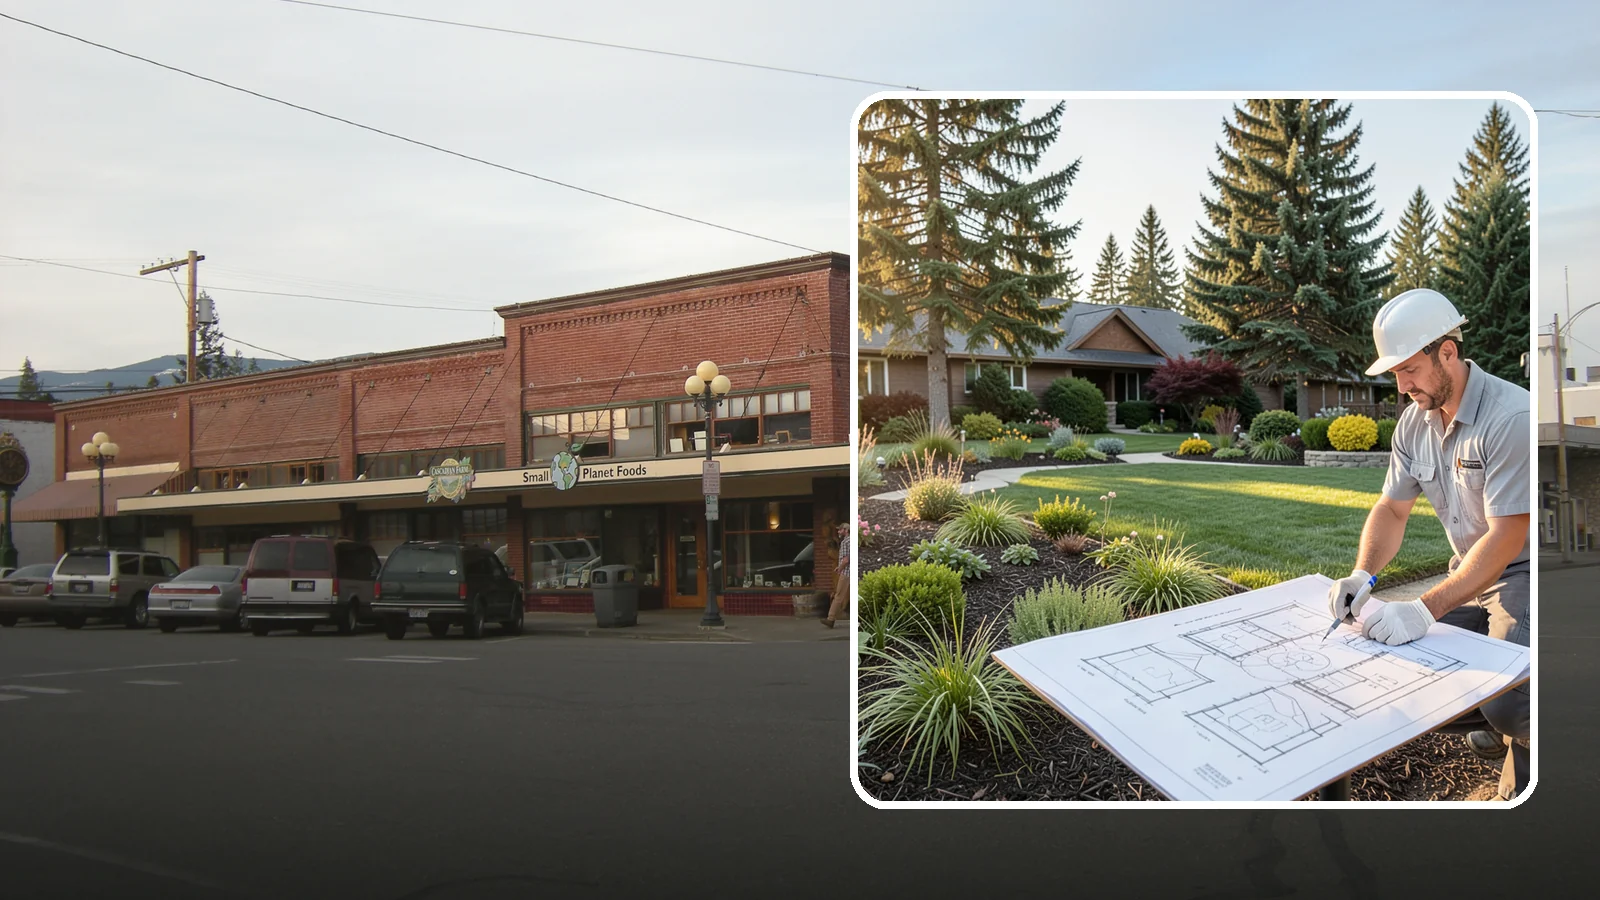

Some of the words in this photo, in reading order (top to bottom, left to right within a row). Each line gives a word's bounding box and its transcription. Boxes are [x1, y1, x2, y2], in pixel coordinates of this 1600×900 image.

[523, 471, 548, 482] Small
[583, 468, 614, 479] Planet
[617, 464, 647, 477] Foods
